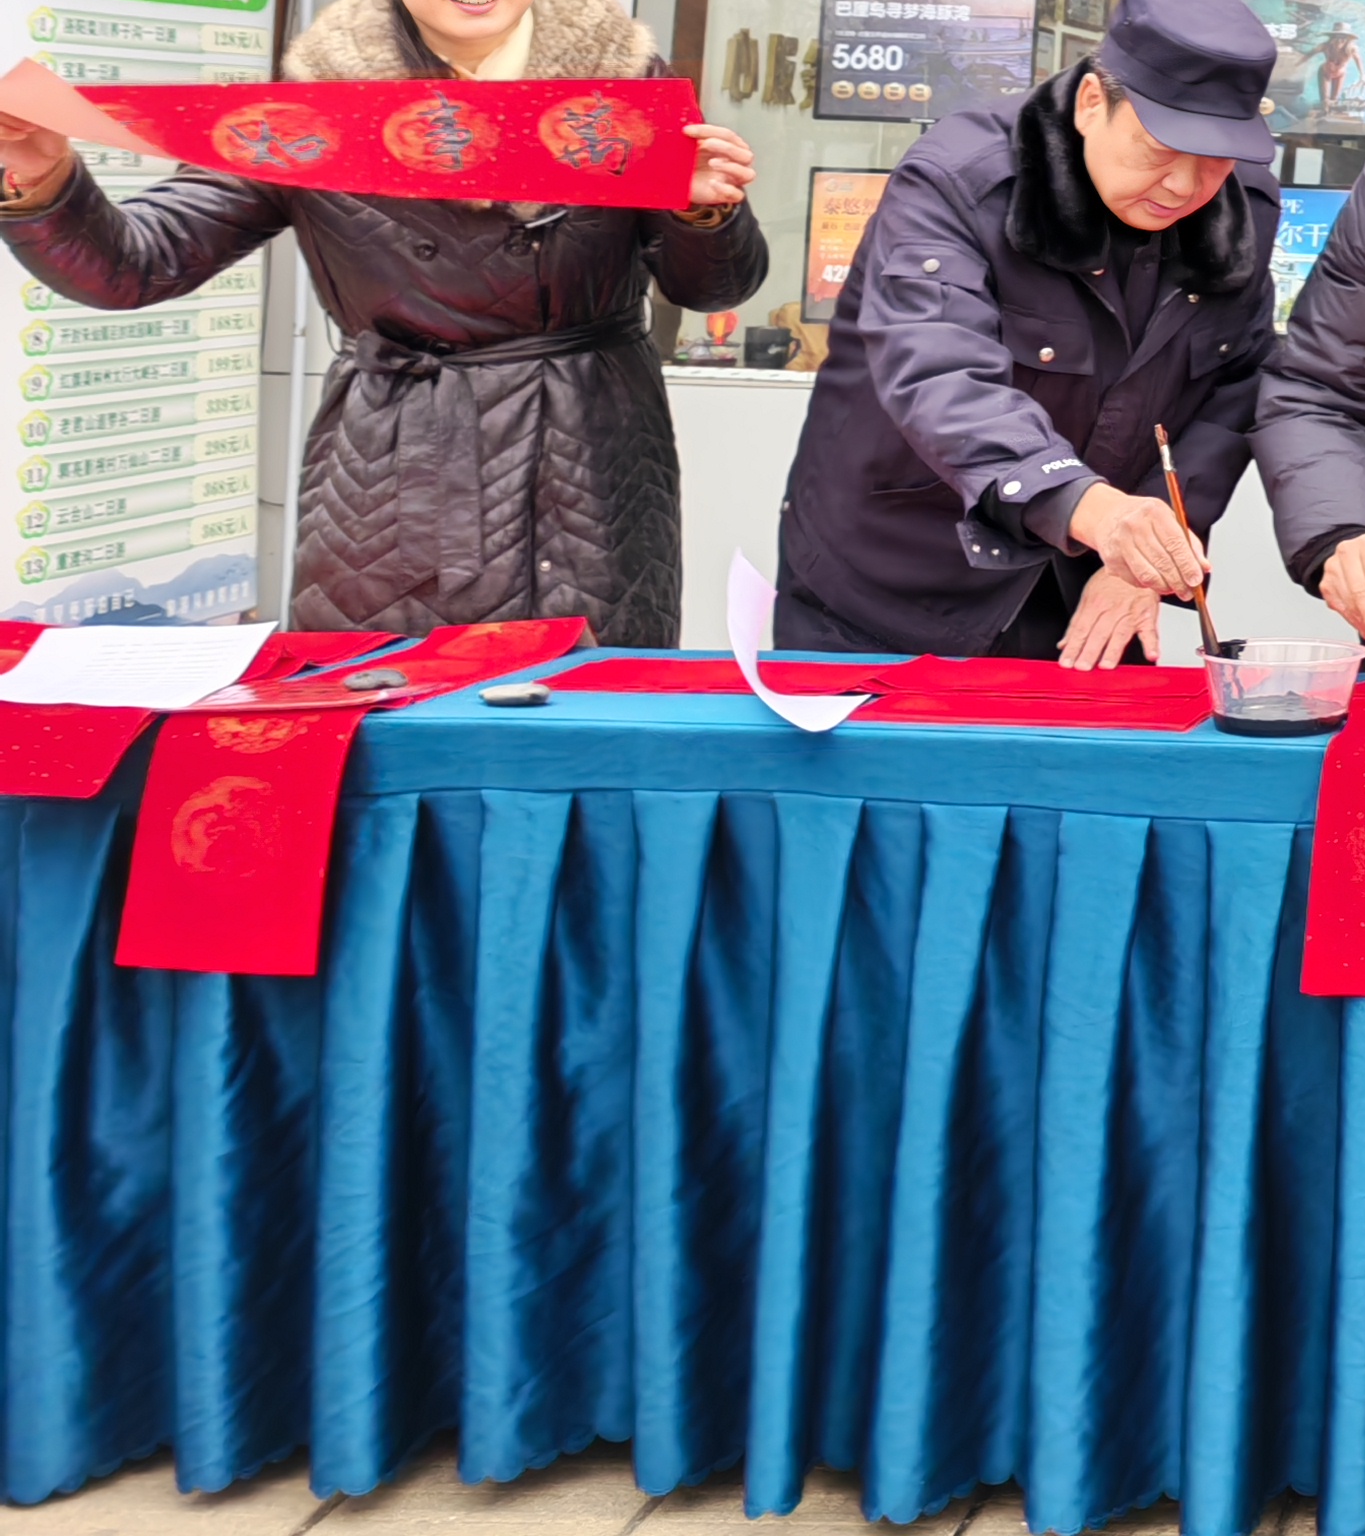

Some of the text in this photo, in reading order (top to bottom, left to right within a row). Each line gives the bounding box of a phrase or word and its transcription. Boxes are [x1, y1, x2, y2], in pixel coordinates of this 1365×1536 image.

[831, 43, 904, 72] 5680
[31, 376, 44, 392] 9
[27, 422, 47, 438] 10
[27, 468, 44, 484] 11
[26, 513, 45, 531] 12
[25, 558, 45, 575] 13
